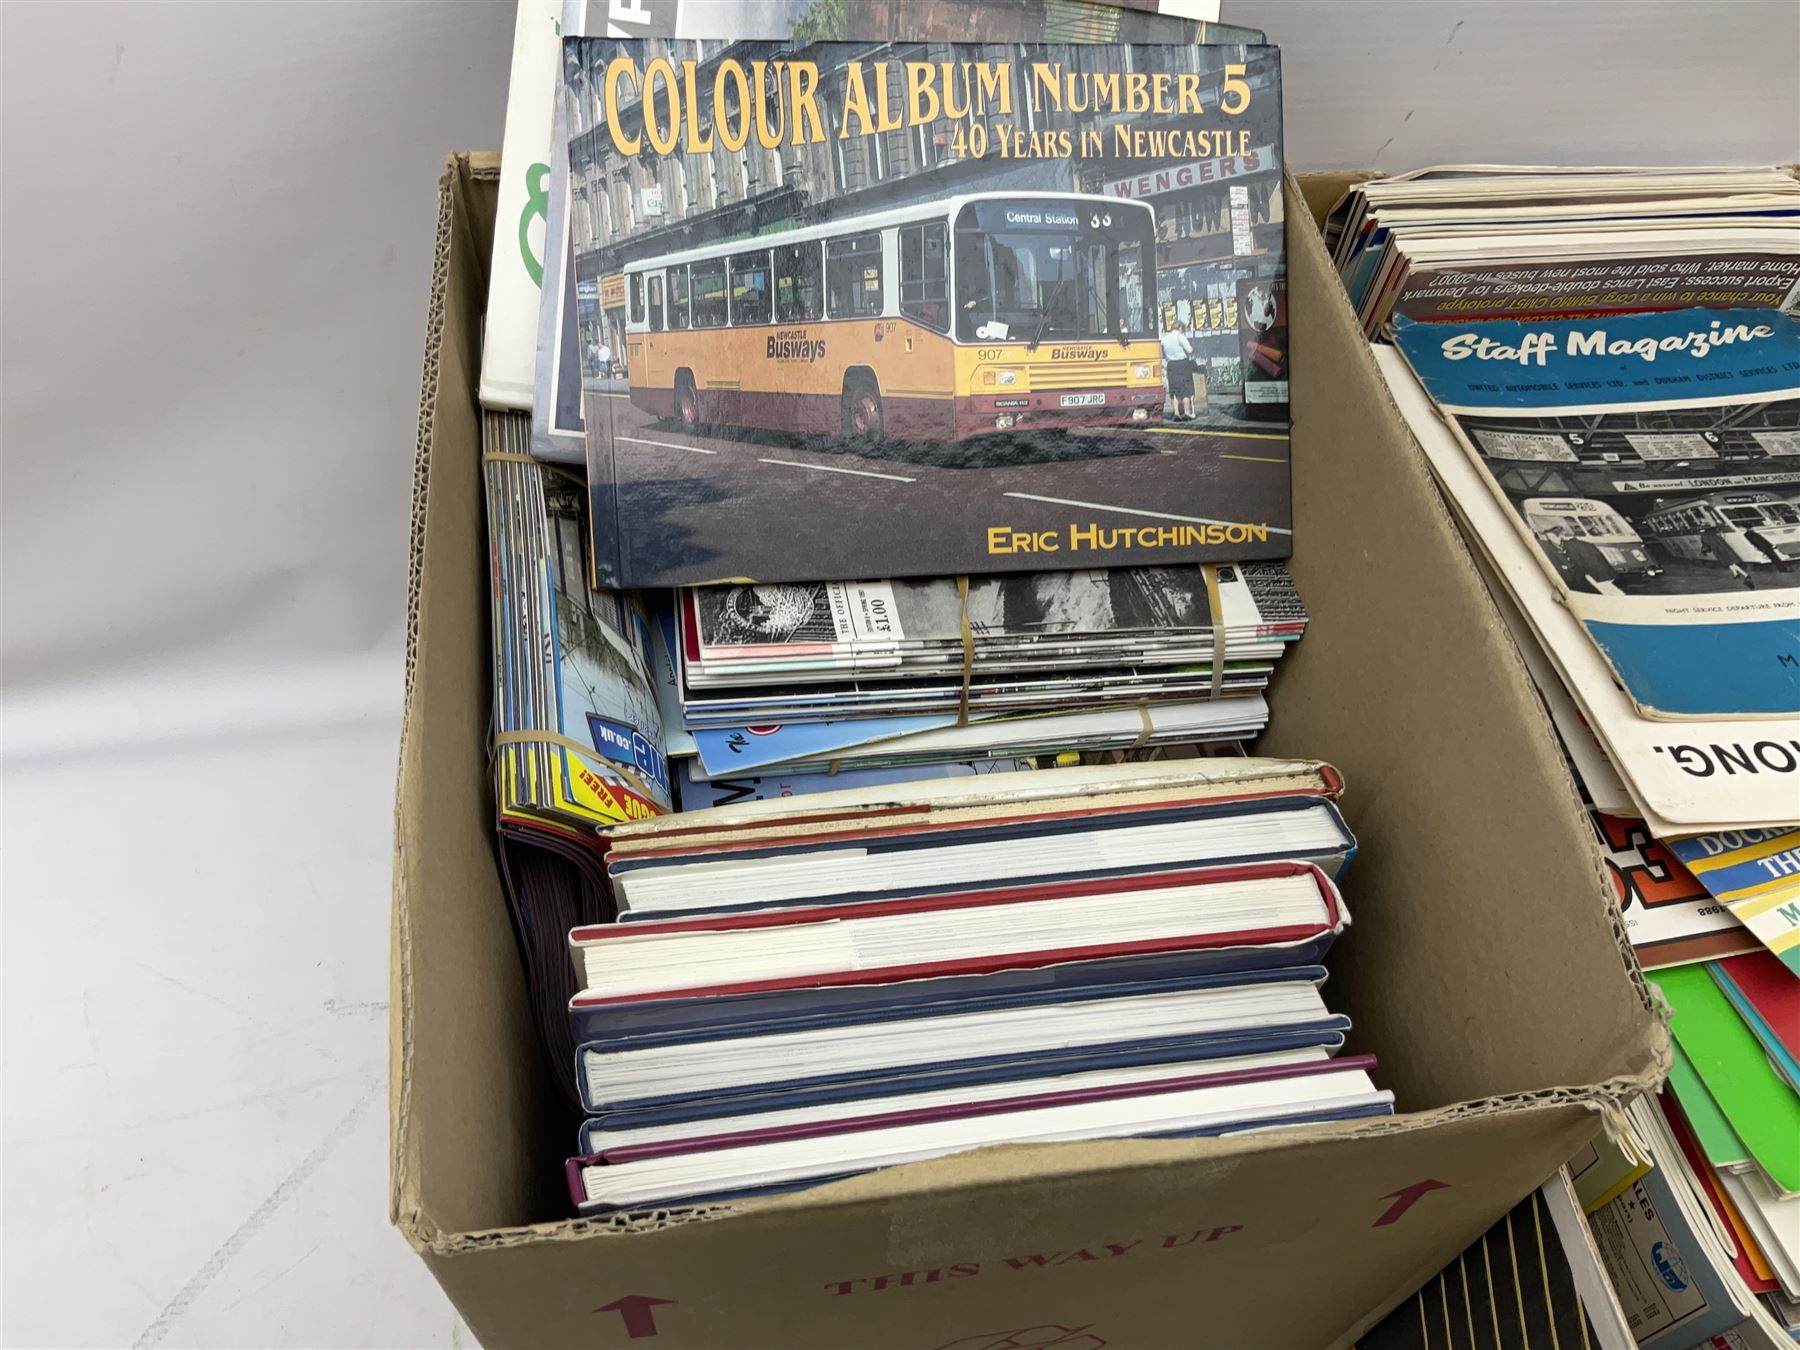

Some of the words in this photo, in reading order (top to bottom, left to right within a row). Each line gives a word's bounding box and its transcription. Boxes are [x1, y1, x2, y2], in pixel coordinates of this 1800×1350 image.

[605, 57, 826, 156] COLOUR
[840, 60, 1013, 140] ALBUM
[1033, 62, 1204, 115] NUMBER
[1220, 63, 1252, 116] 5
[950, 121, 988, 160] 40
[996, 123, 1073, 159] YEARS
[1081, 131, 1103, 158] IN
[1114, 123, 1253, 159] NEWCASTLE
[1114, 153, 1261, 198] WENGERS
[1006, 211, 1042, 224] Central
[1044, 214, 1079, 225] Station
[1539, 268, 1571, 279] new
[1571, 266, 1611, 279] most
[1611, 265, 1635, 277] the
[1634, 263, 1668, 276] sold
[1669, 262, 1701, 274] Who
[1760, 261, 1800, 276] Home
[1496, 270, 1539, 281] buses
[1646, 276, 1680, 289] East
[1681, 275, 1745, 287] success:
[1744, 274, 1795, 290] Export
[1468, 284, 1492, 297] for
[1492, 280, 1601, 296] double-deckers
[1602, 278, 1647, 290] Lancs
[1401, 287, 1468, 302] Denmark
[1652, 291, 1678, 304] win
[1681, 291, 1696, 302] to
[1698, 291, 1749, 304] chance
[1748, 291, 1783, 305] Your
[1437, 296, 1509, 311] prototype
[767, 335, 826, 363] Busways
[1440, 332, 1559, 366] Staff
[1566, 320, 1775, 361] Magazine
[978, 349, 1003, 361] 907
[1051, 347, 1109, 361] Busways
[1568, 433, 1585, 446] 5
[1688, 478, 1734, 488] LONDON
[987, 526, 1060, 555] ERIC
[1070, 522, 1267, 552] HUTCHINSON
[870, 599, 892, 632] £1.00
[838, 618, 850, 635] THE
[1652, 740, 1800, 778] ONG.
[578, 769, 614, 809] FREE!
[823, 1262, 982, 1297] THIS
[1002, 1238, 1144, 1271] WAY
[1161, 1224, 1245, 1249] UP
